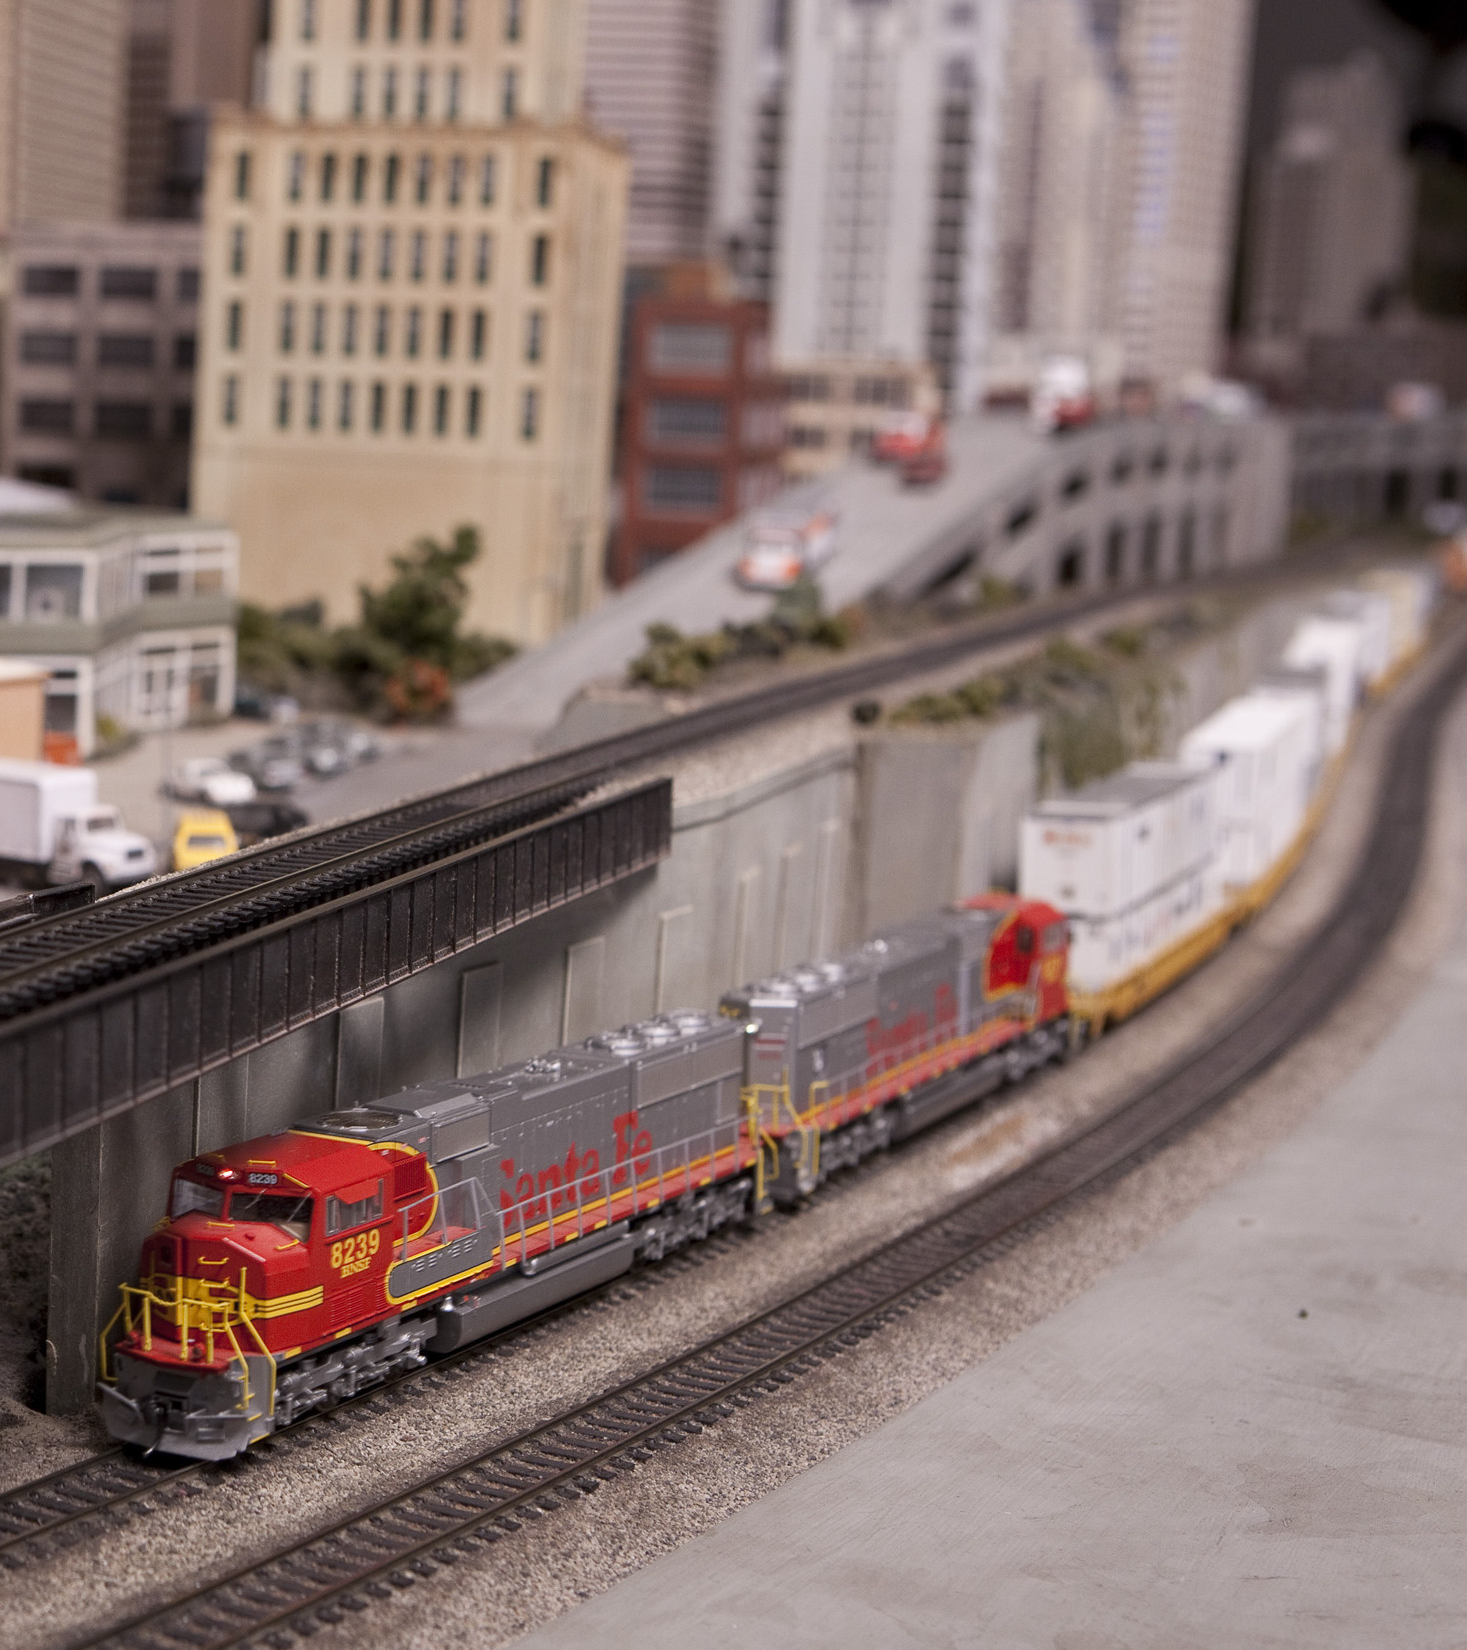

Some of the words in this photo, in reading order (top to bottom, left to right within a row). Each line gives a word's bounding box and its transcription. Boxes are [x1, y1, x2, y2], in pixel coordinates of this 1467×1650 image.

[612, 1109, 653, 1184] Fe
[248, 1173, 278, 1185] 8239
[331, 1228, 380, 1269] 8239
[340, 1256, 372, 1279] BNSF
